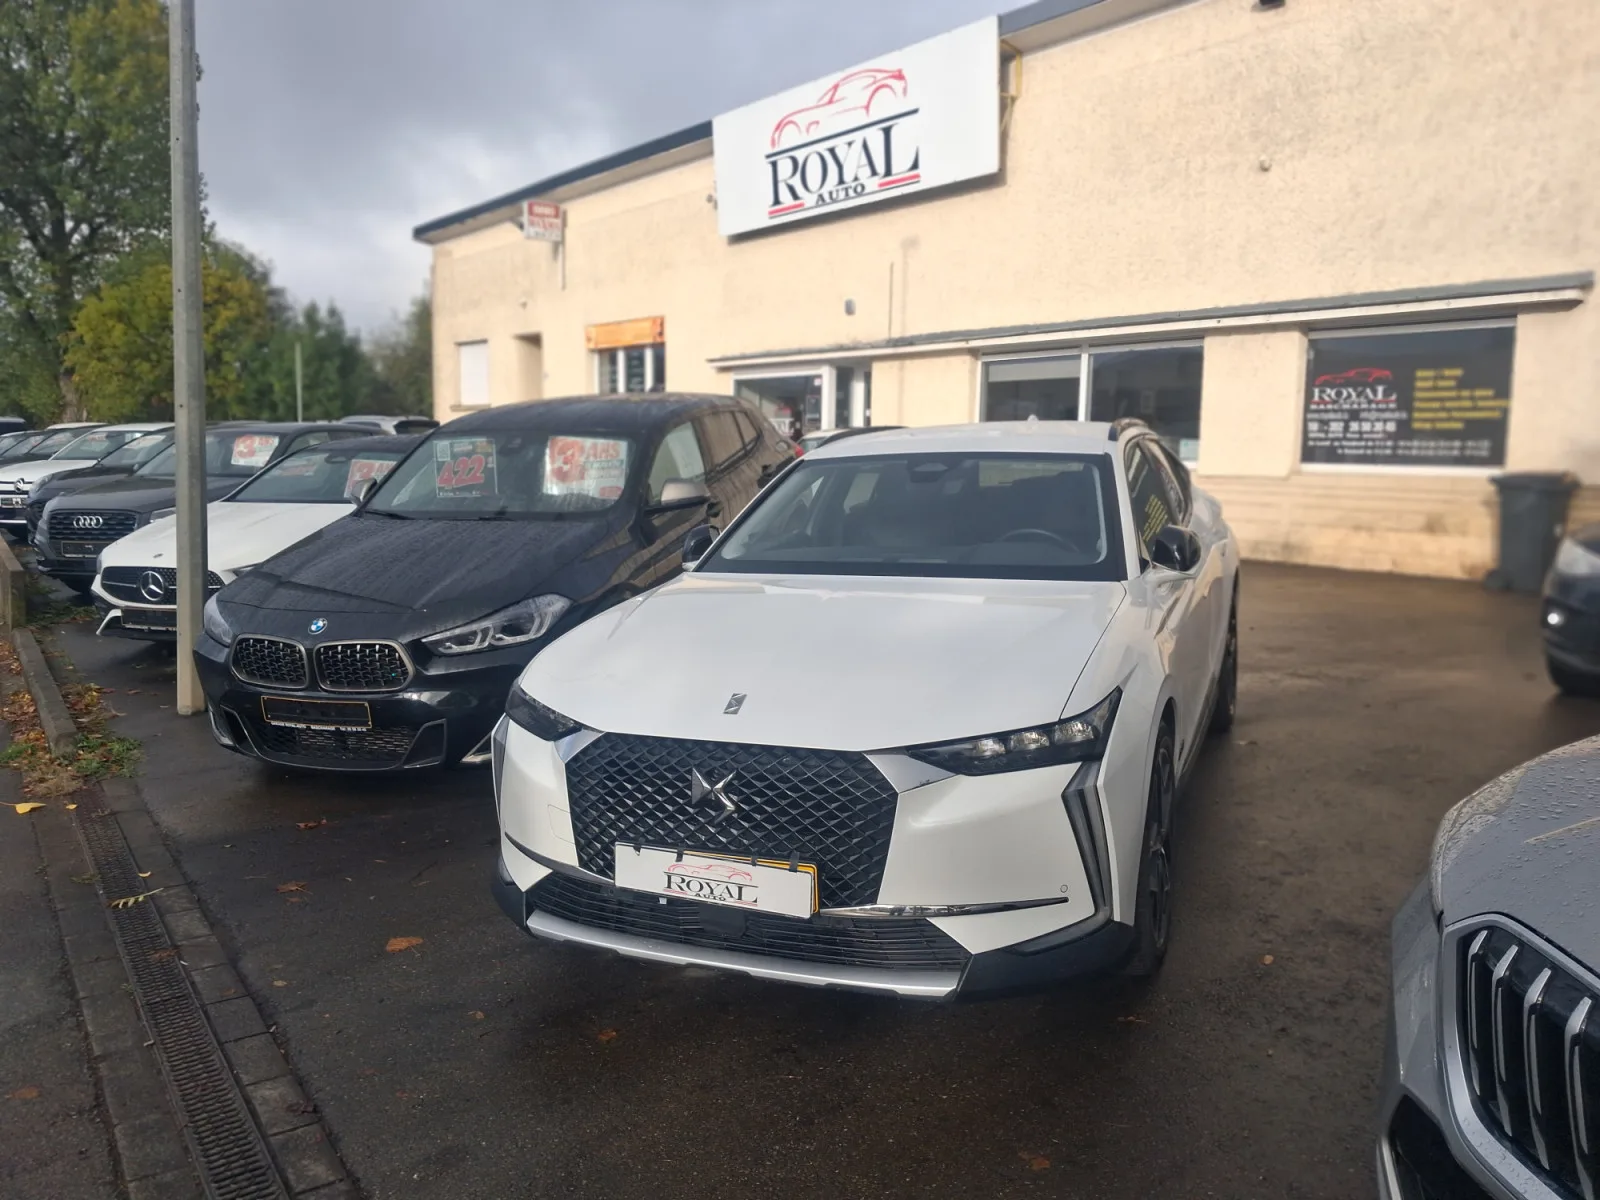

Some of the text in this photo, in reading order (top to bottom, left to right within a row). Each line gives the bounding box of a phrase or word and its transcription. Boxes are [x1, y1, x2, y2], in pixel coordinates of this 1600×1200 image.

[768, 122, 920, 207] ROYAL
[816, 182, 866, 205] AUTO
[1311, 385, 1397, 402] ROYAL
[666, 873, 758, 904] ROYAL
[694, 893, 727, 902] AUTO
